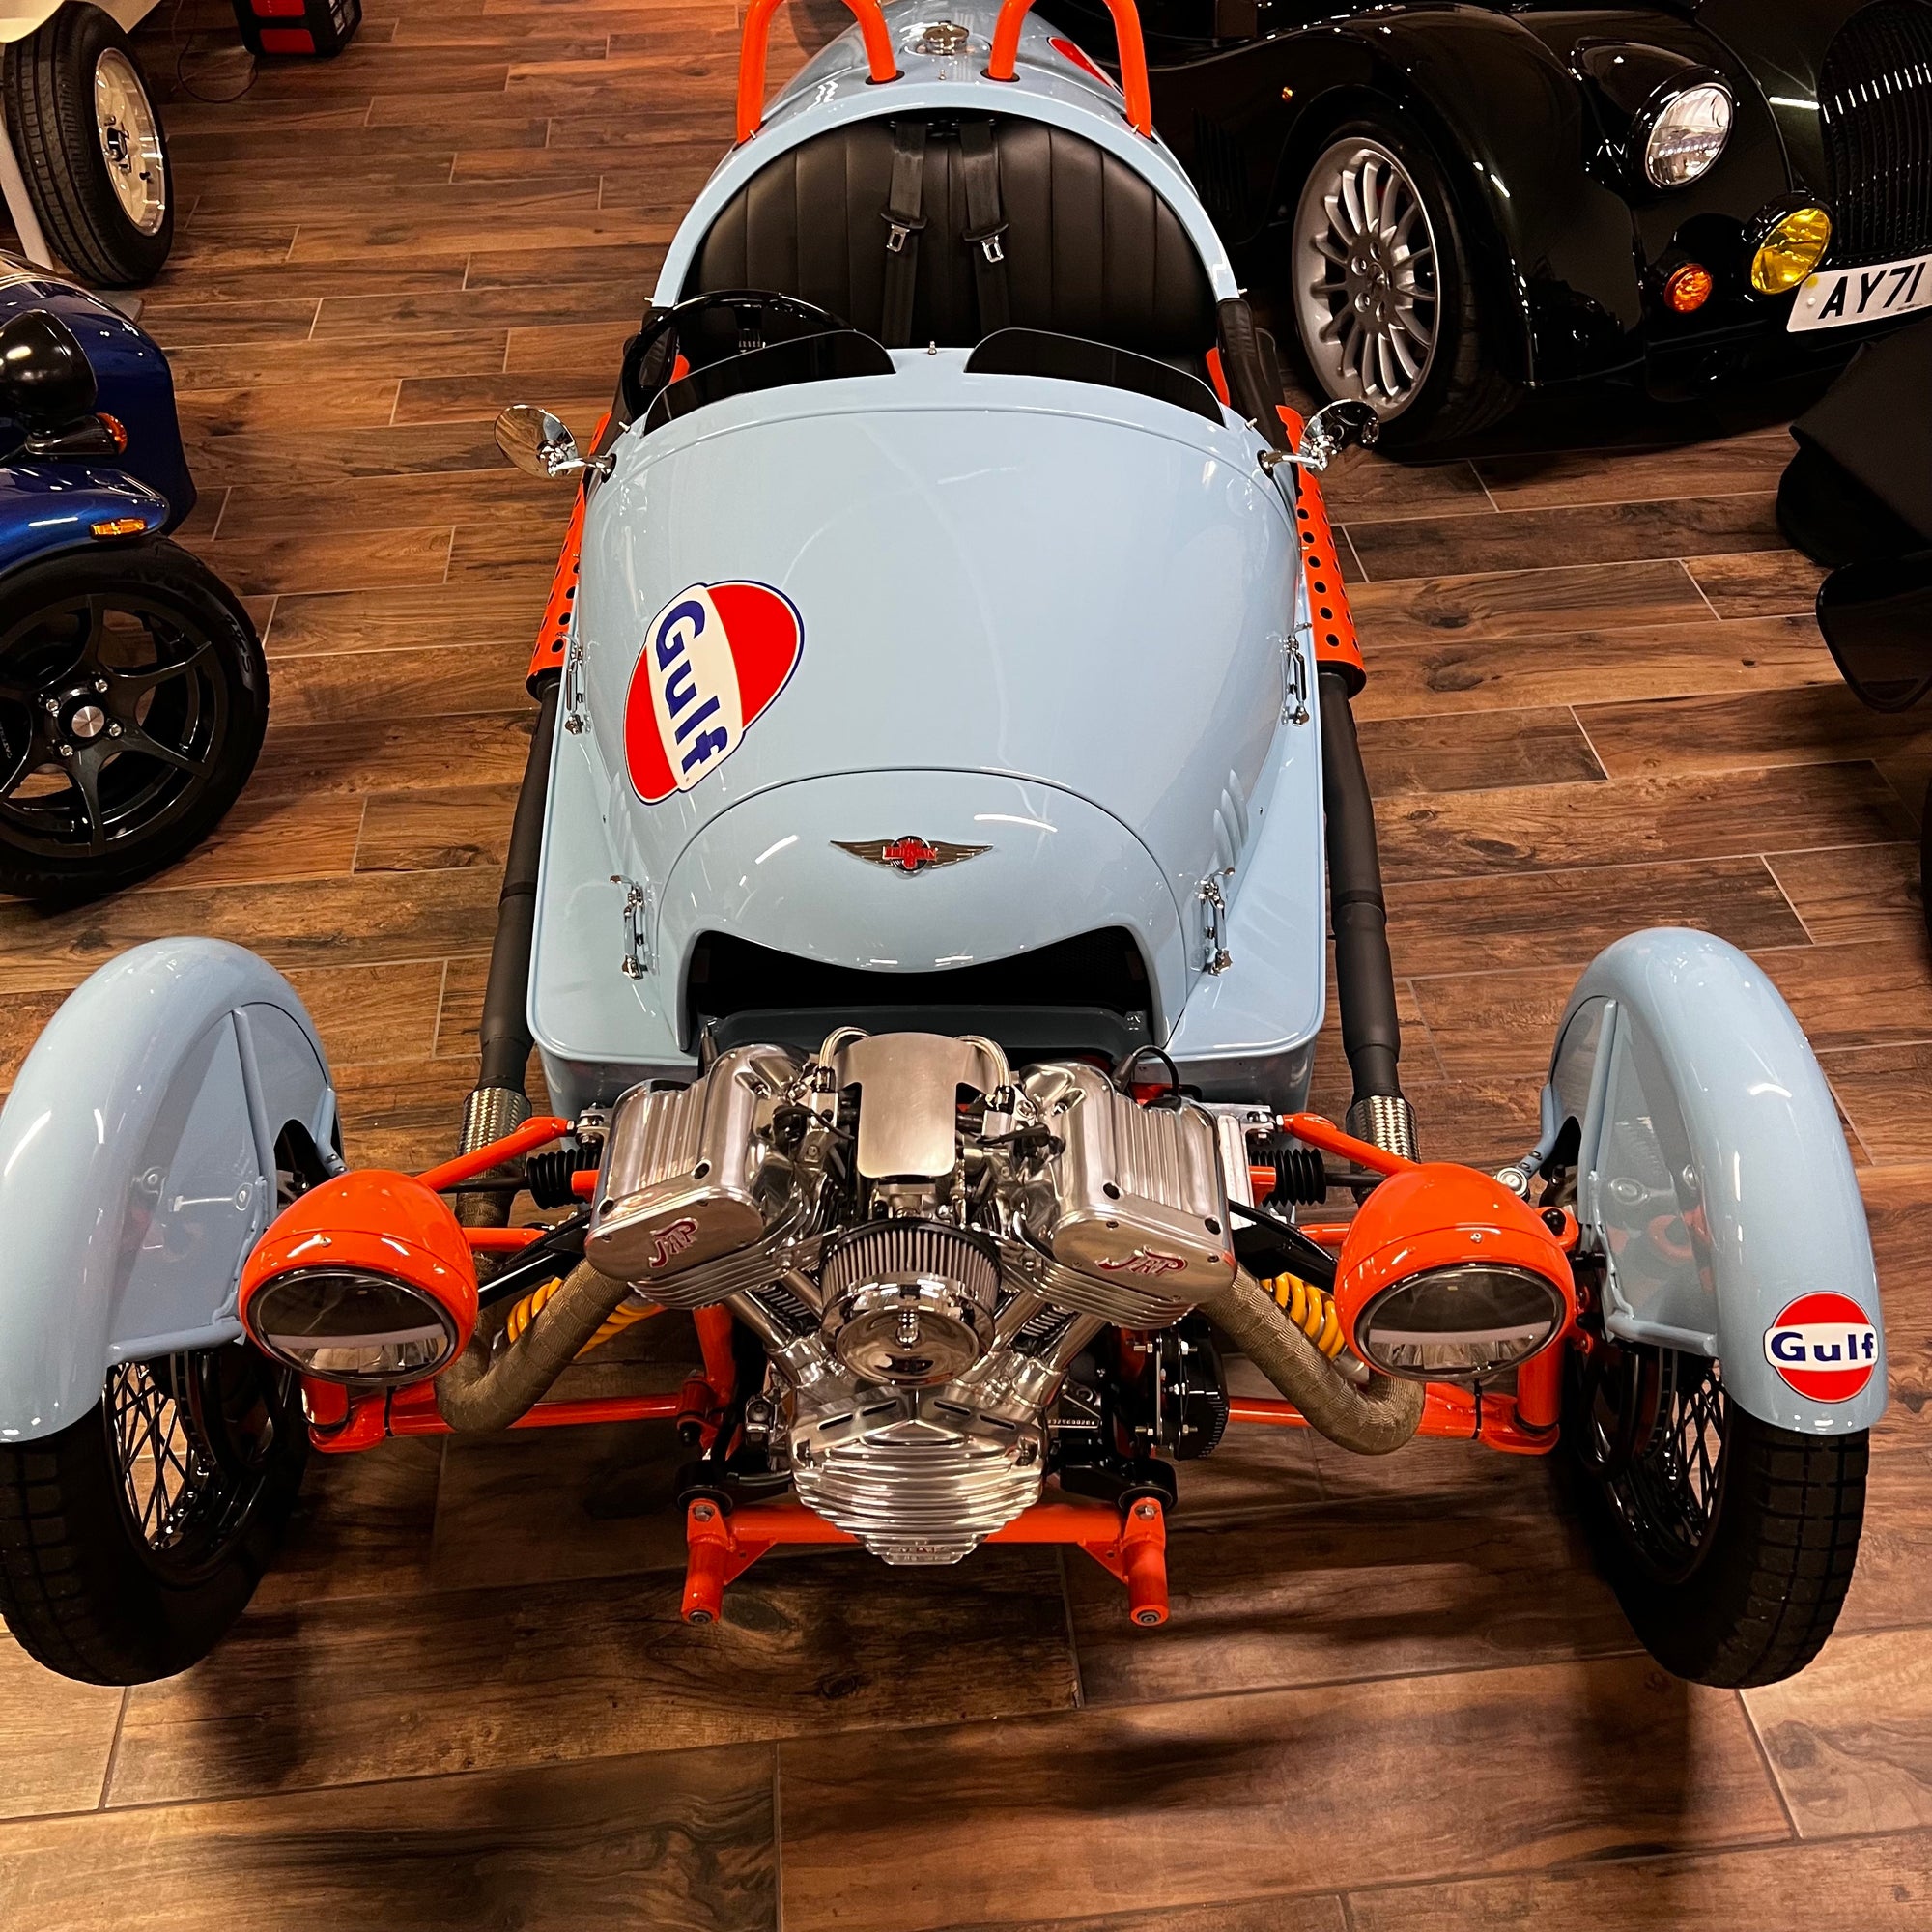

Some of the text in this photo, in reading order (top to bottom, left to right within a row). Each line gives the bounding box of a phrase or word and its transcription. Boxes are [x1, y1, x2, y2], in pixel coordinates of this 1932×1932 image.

[1818, 262, 1926, 320] AY71
[655, 600, 728, 774] Gulf
[649, 1217, 698, 1268] JAP
[1094, 1245, 1186, 1276] JAP
[1770, 1331, 1874, 1362] Gulf
